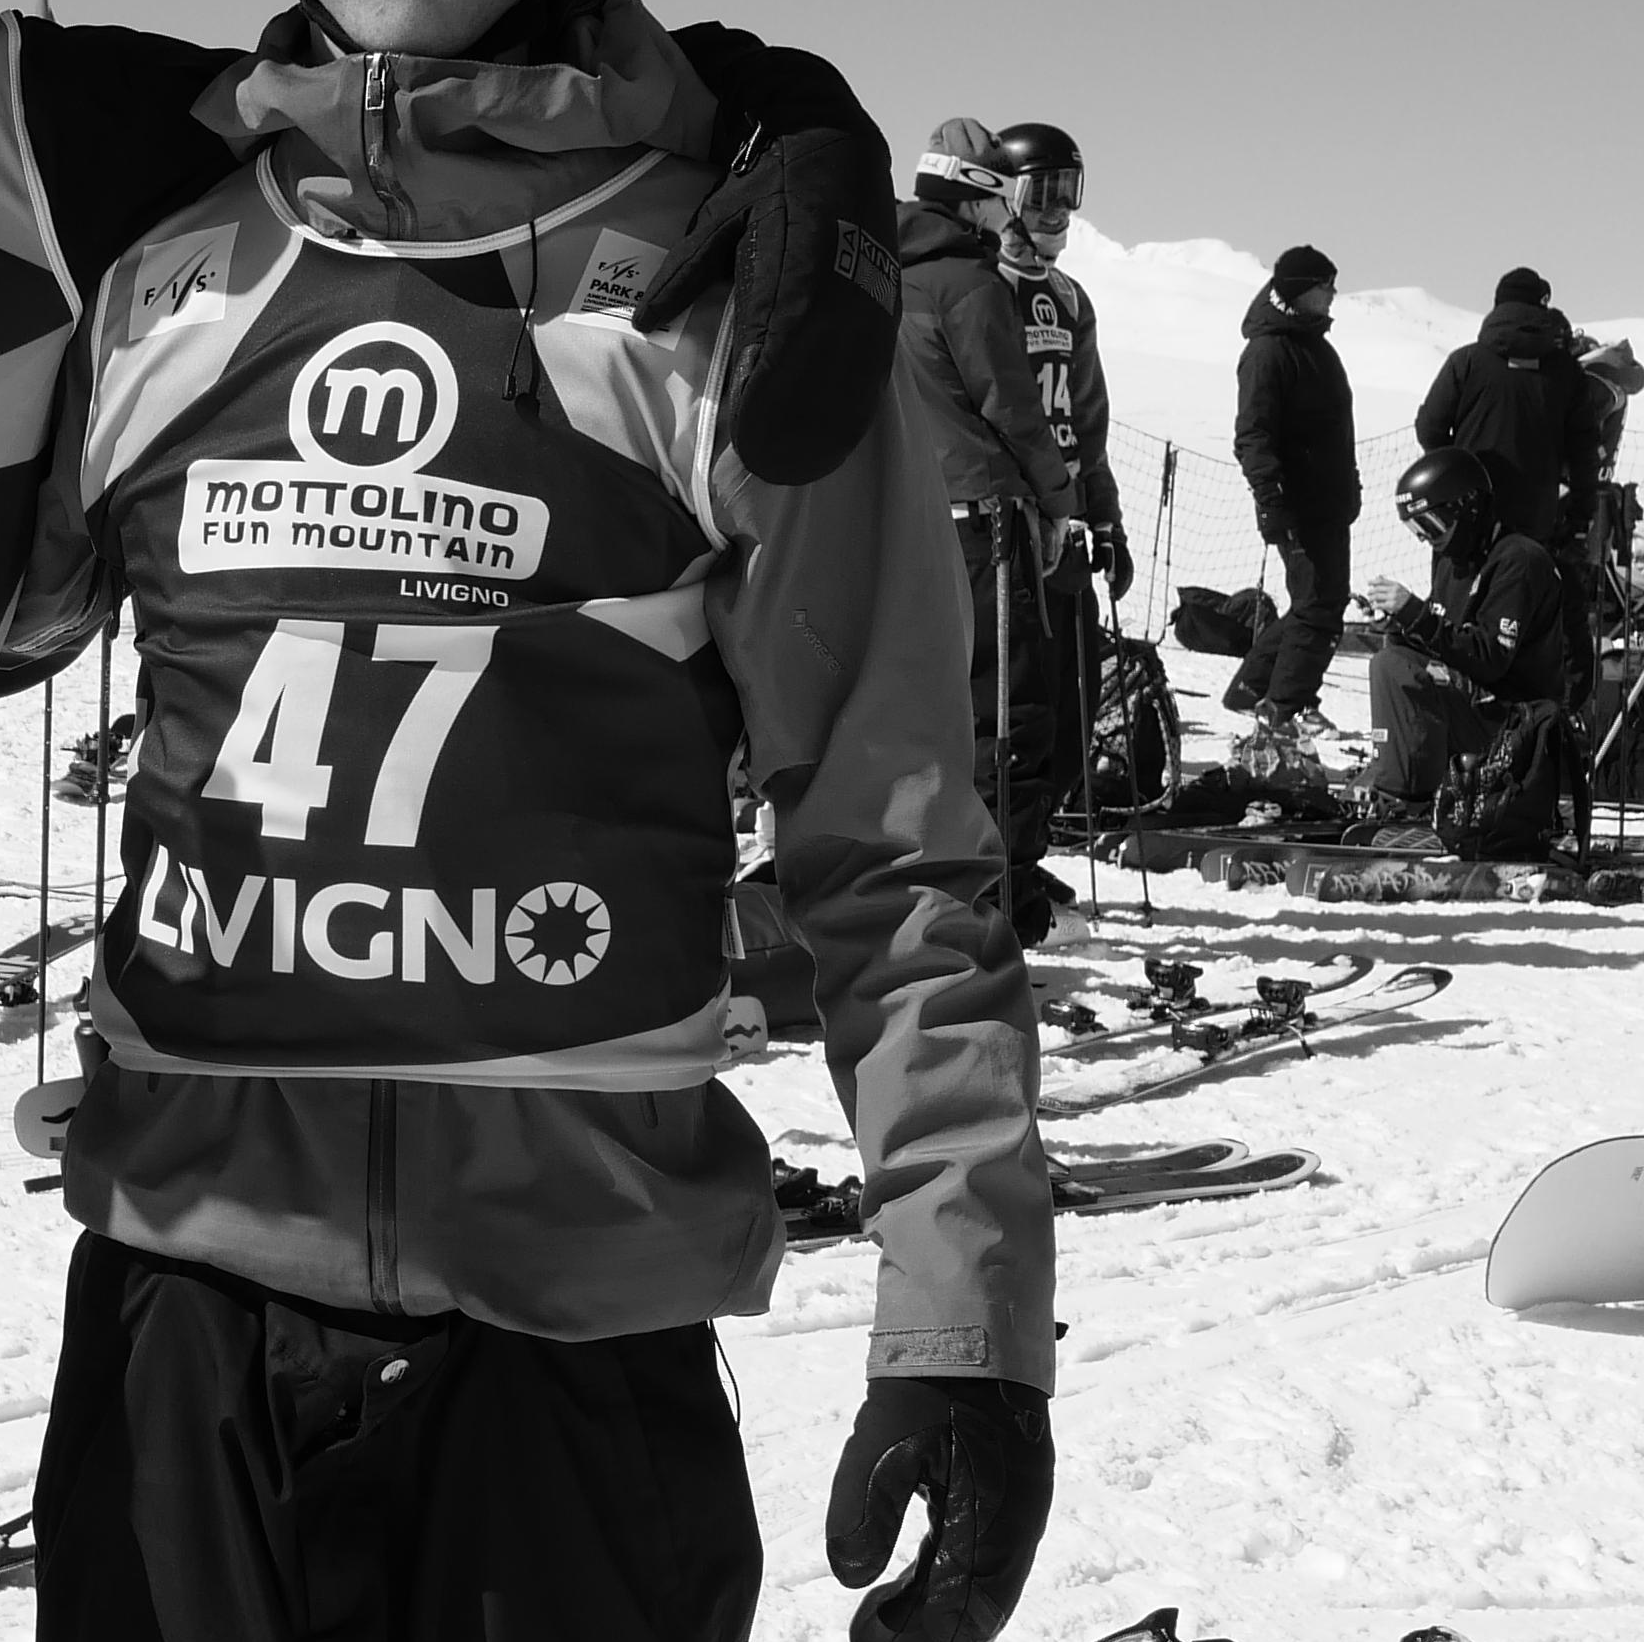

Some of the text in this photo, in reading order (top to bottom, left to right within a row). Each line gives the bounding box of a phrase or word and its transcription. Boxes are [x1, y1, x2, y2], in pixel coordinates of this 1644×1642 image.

[143, 274, 207, 306] FIS
[589, 279, 633, 299] PARK
[1036, 362, 1072, 417] 14
[399, 577, 510, 608] LIVIGNO
[200, 618, 501, 848] 47
[138, 844, 612, 987] LIVIGNO
